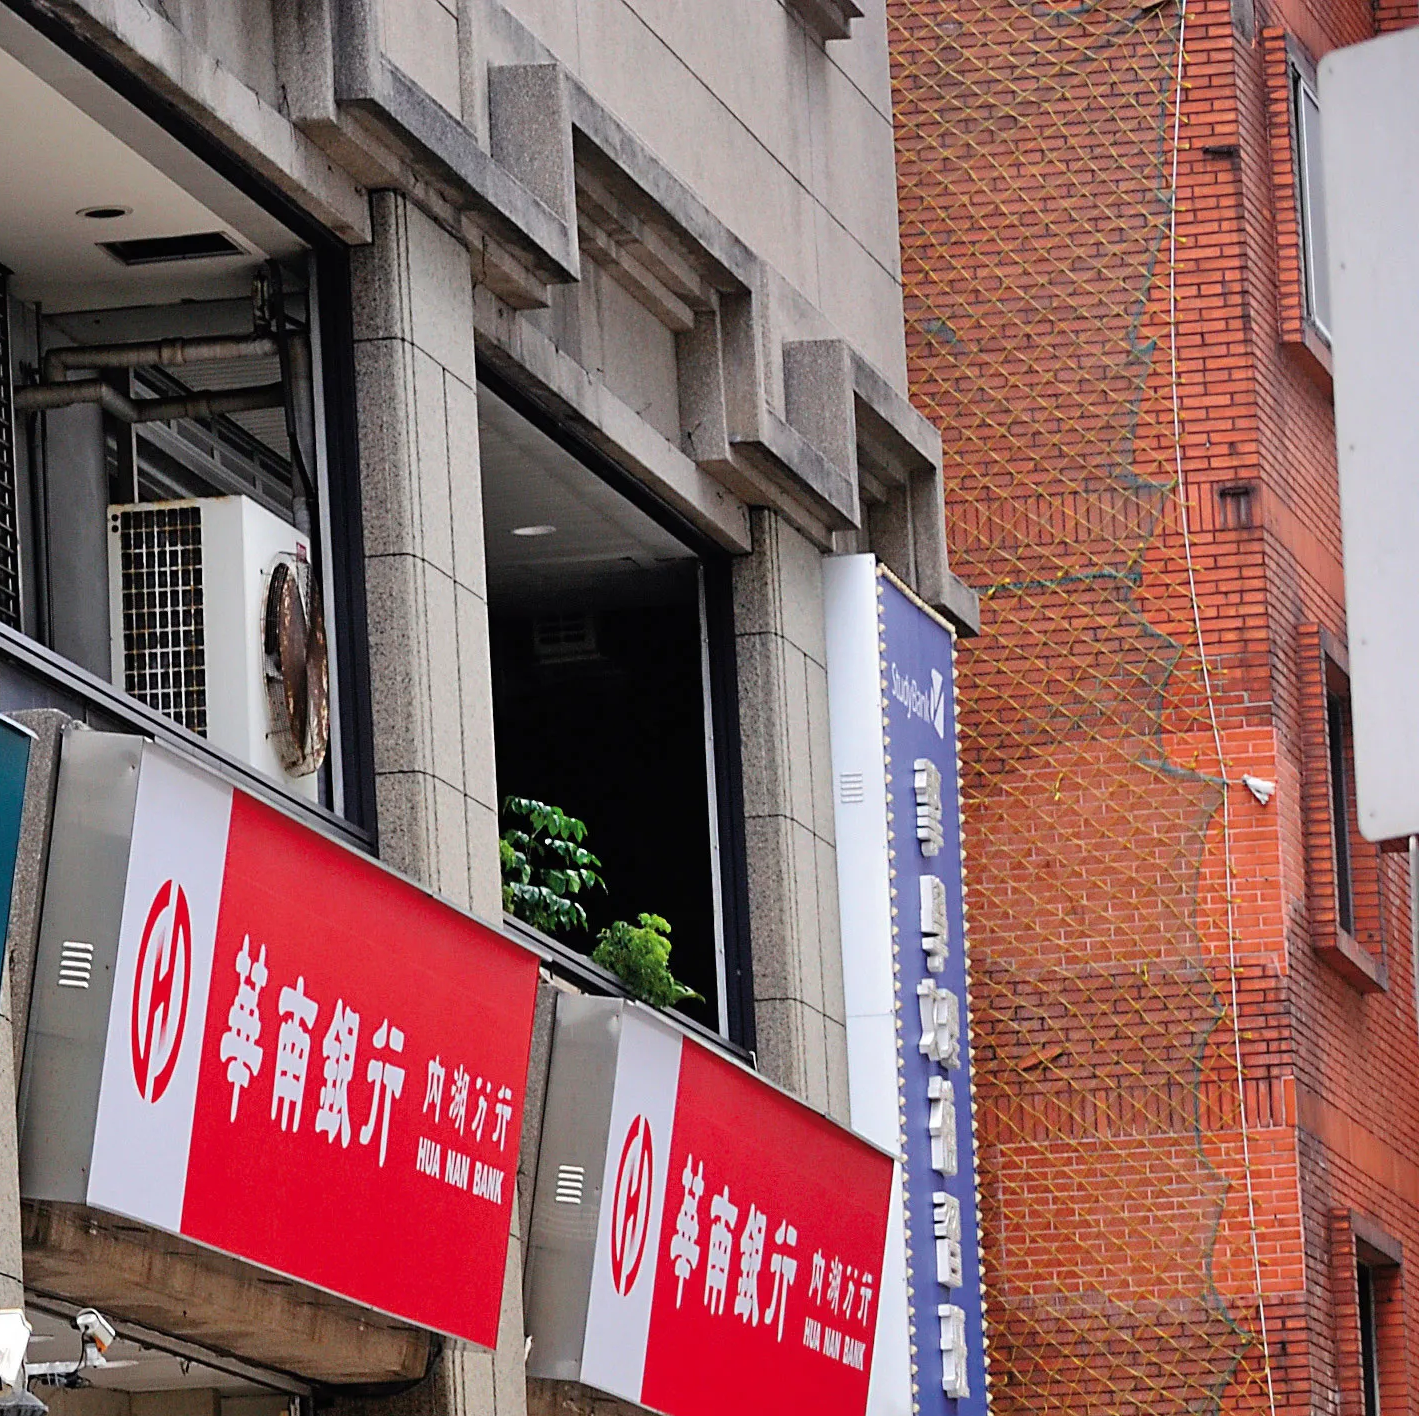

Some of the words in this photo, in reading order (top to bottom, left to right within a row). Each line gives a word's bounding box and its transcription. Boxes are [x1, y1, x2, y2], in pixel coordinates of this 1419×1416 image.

[890, 660, 931, 724] StudyBank
[219, 932, 405, 1169] 華南銀行
[416, 1135, 441, 1178] HUA
[444, 1151, 471, 1192] NAN
[472, 1165, 505, 1206] BANK
[669, 1153, 797, 1343] 華南銀行
[803, 1317, 821, 1352] HUA
[823, 1328, 842, 1362] NAN
[843, 1338, 866, 1371] BANK
